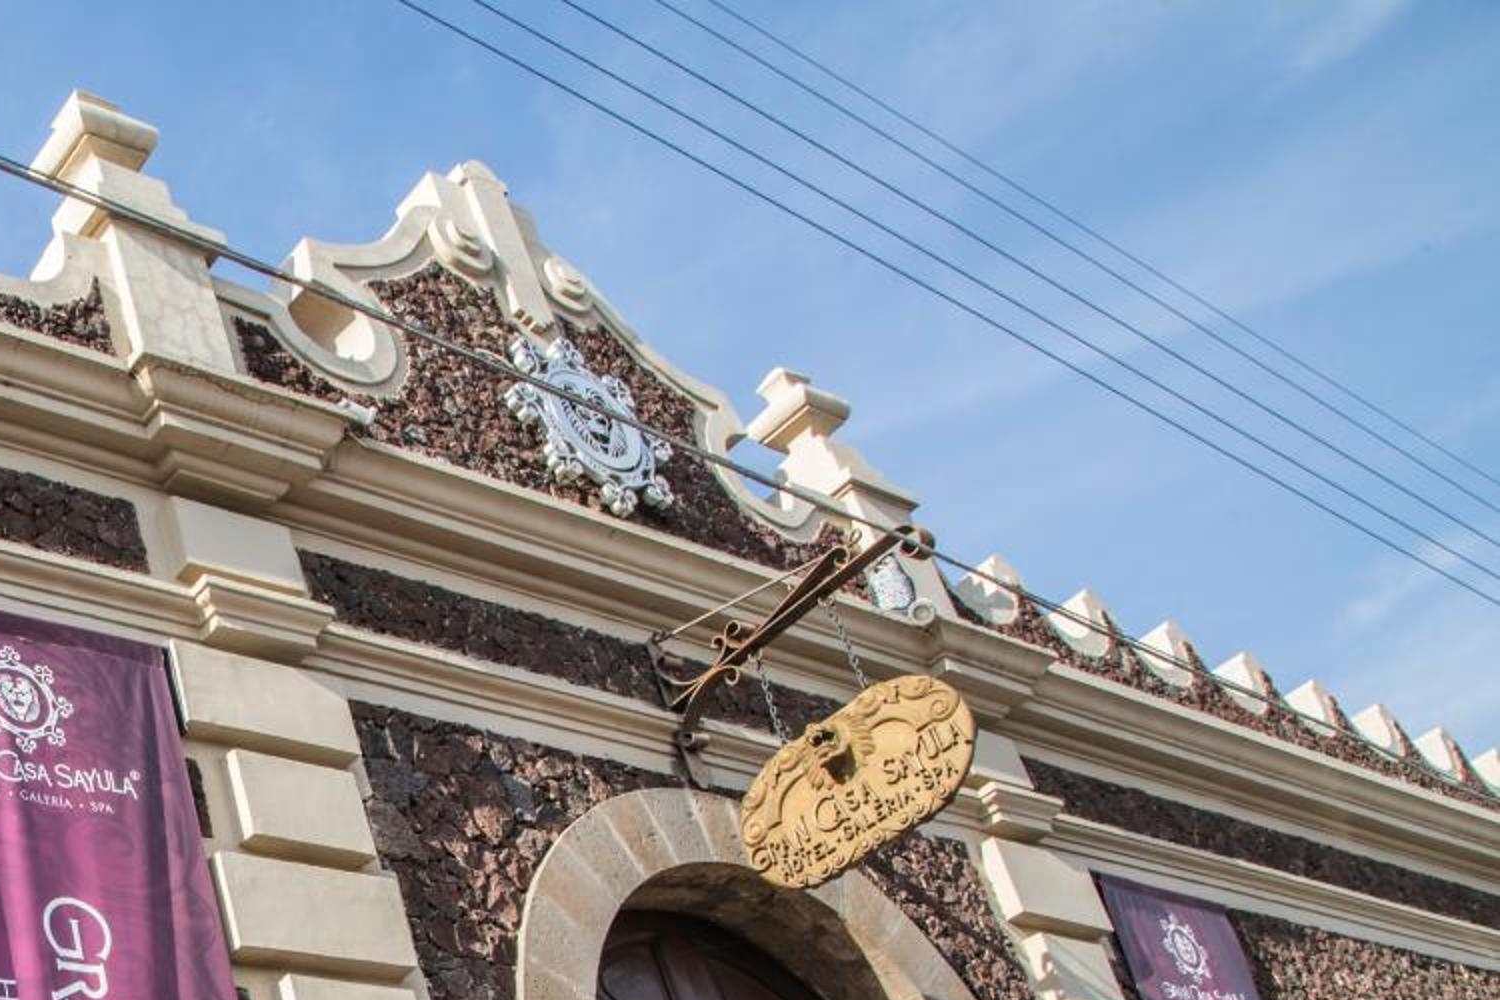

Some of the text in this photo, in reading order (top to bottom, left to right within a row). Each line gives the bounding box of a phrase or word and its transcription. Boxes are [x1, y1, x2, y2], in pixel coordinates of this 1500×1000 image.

[89, 800, 116, 815] SPA
[751, 721, 963, 873] GRAN CASA SAYULA
[781, 841, 838, 883] HOTEL
[920, 757, 959, 790] SPA
